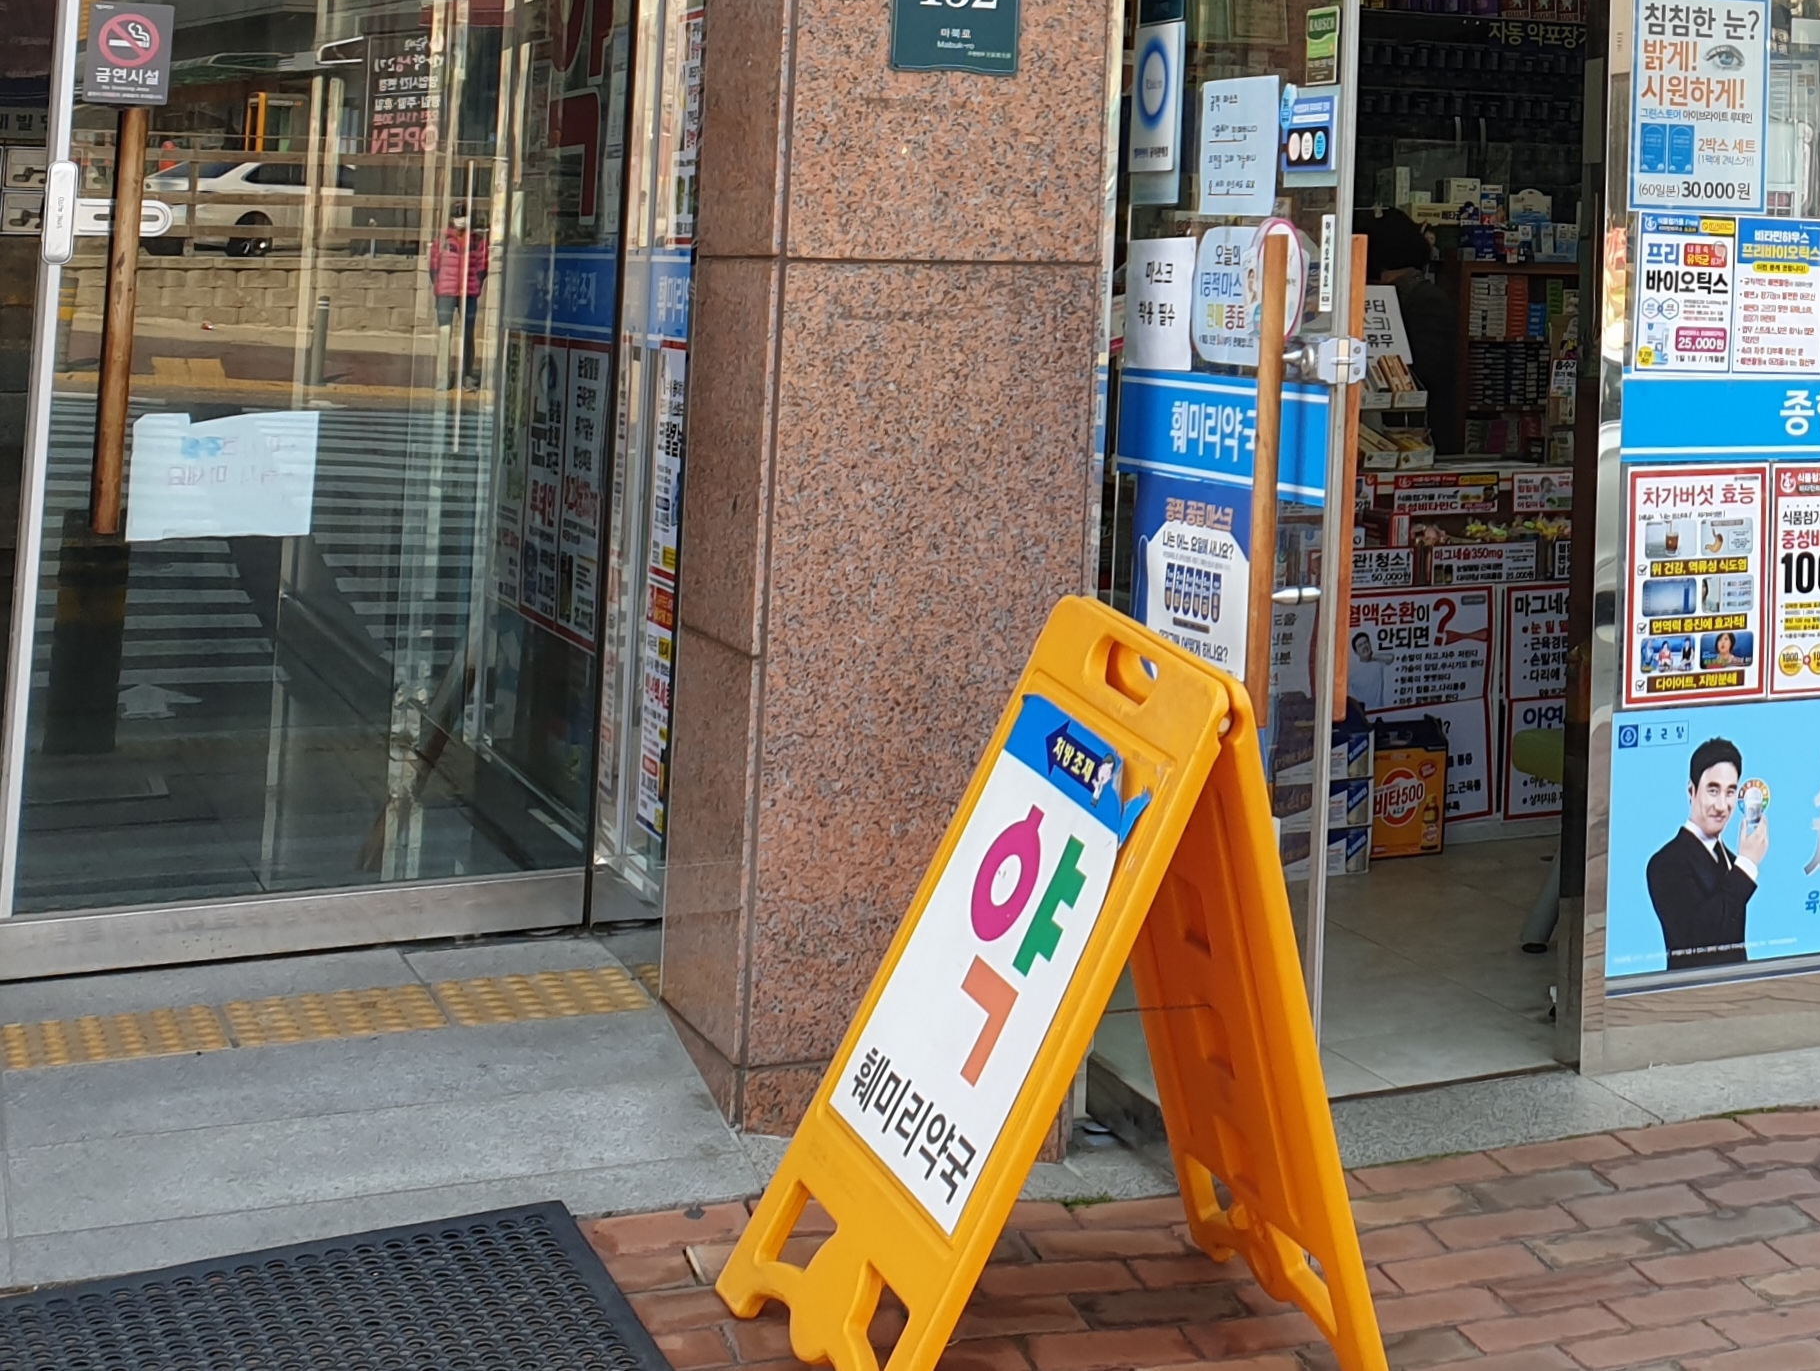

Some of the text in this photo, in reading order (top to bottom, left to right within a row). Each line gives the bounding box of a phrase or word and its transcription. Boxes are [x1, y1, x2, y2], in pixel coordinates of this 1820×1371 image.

[1644, 3, 1760, 40] 침침한 눈?
[1488, 21, 1524, 46] 자동
[1643, 39, 1698, 72] 밝게!
[95, 67, 160, 85] 금연시설
[1641, 75, 1745, 110] 시원하게!
[1698, 137, 1756, 153] 2박스 세트
[1754, 230, 1809, 243] 비타민하우스
[1215, 244, 1241, 266] 오늘의
[1646, 243, 1680, 266] 프리
[1741, 243, 1820, 261] 프리바이오틱스
[1145, 261, 1174, 284] 마스크
[1646, 270, 1729, 294] 바이오틱스
[1138, 301, 1176, 327] 착용 필수
[1678, 337, 1725, 350] 25,000원
[1642, 483, 1756, 508] 차가버섯 효능
[1165, 497, 1234, 532] 공적 공급 마스크
[1375, 550, 1411, 567] 청소!
[1688, 560, 1717, 573] 역류성
[1377, 627, 1430, 650] 안되면
[1052, 734, 1096, 788] 처방조제
[969, 802, 1090, 1088] 약
[850, 1045, 980, 1204] 훼미리약국
